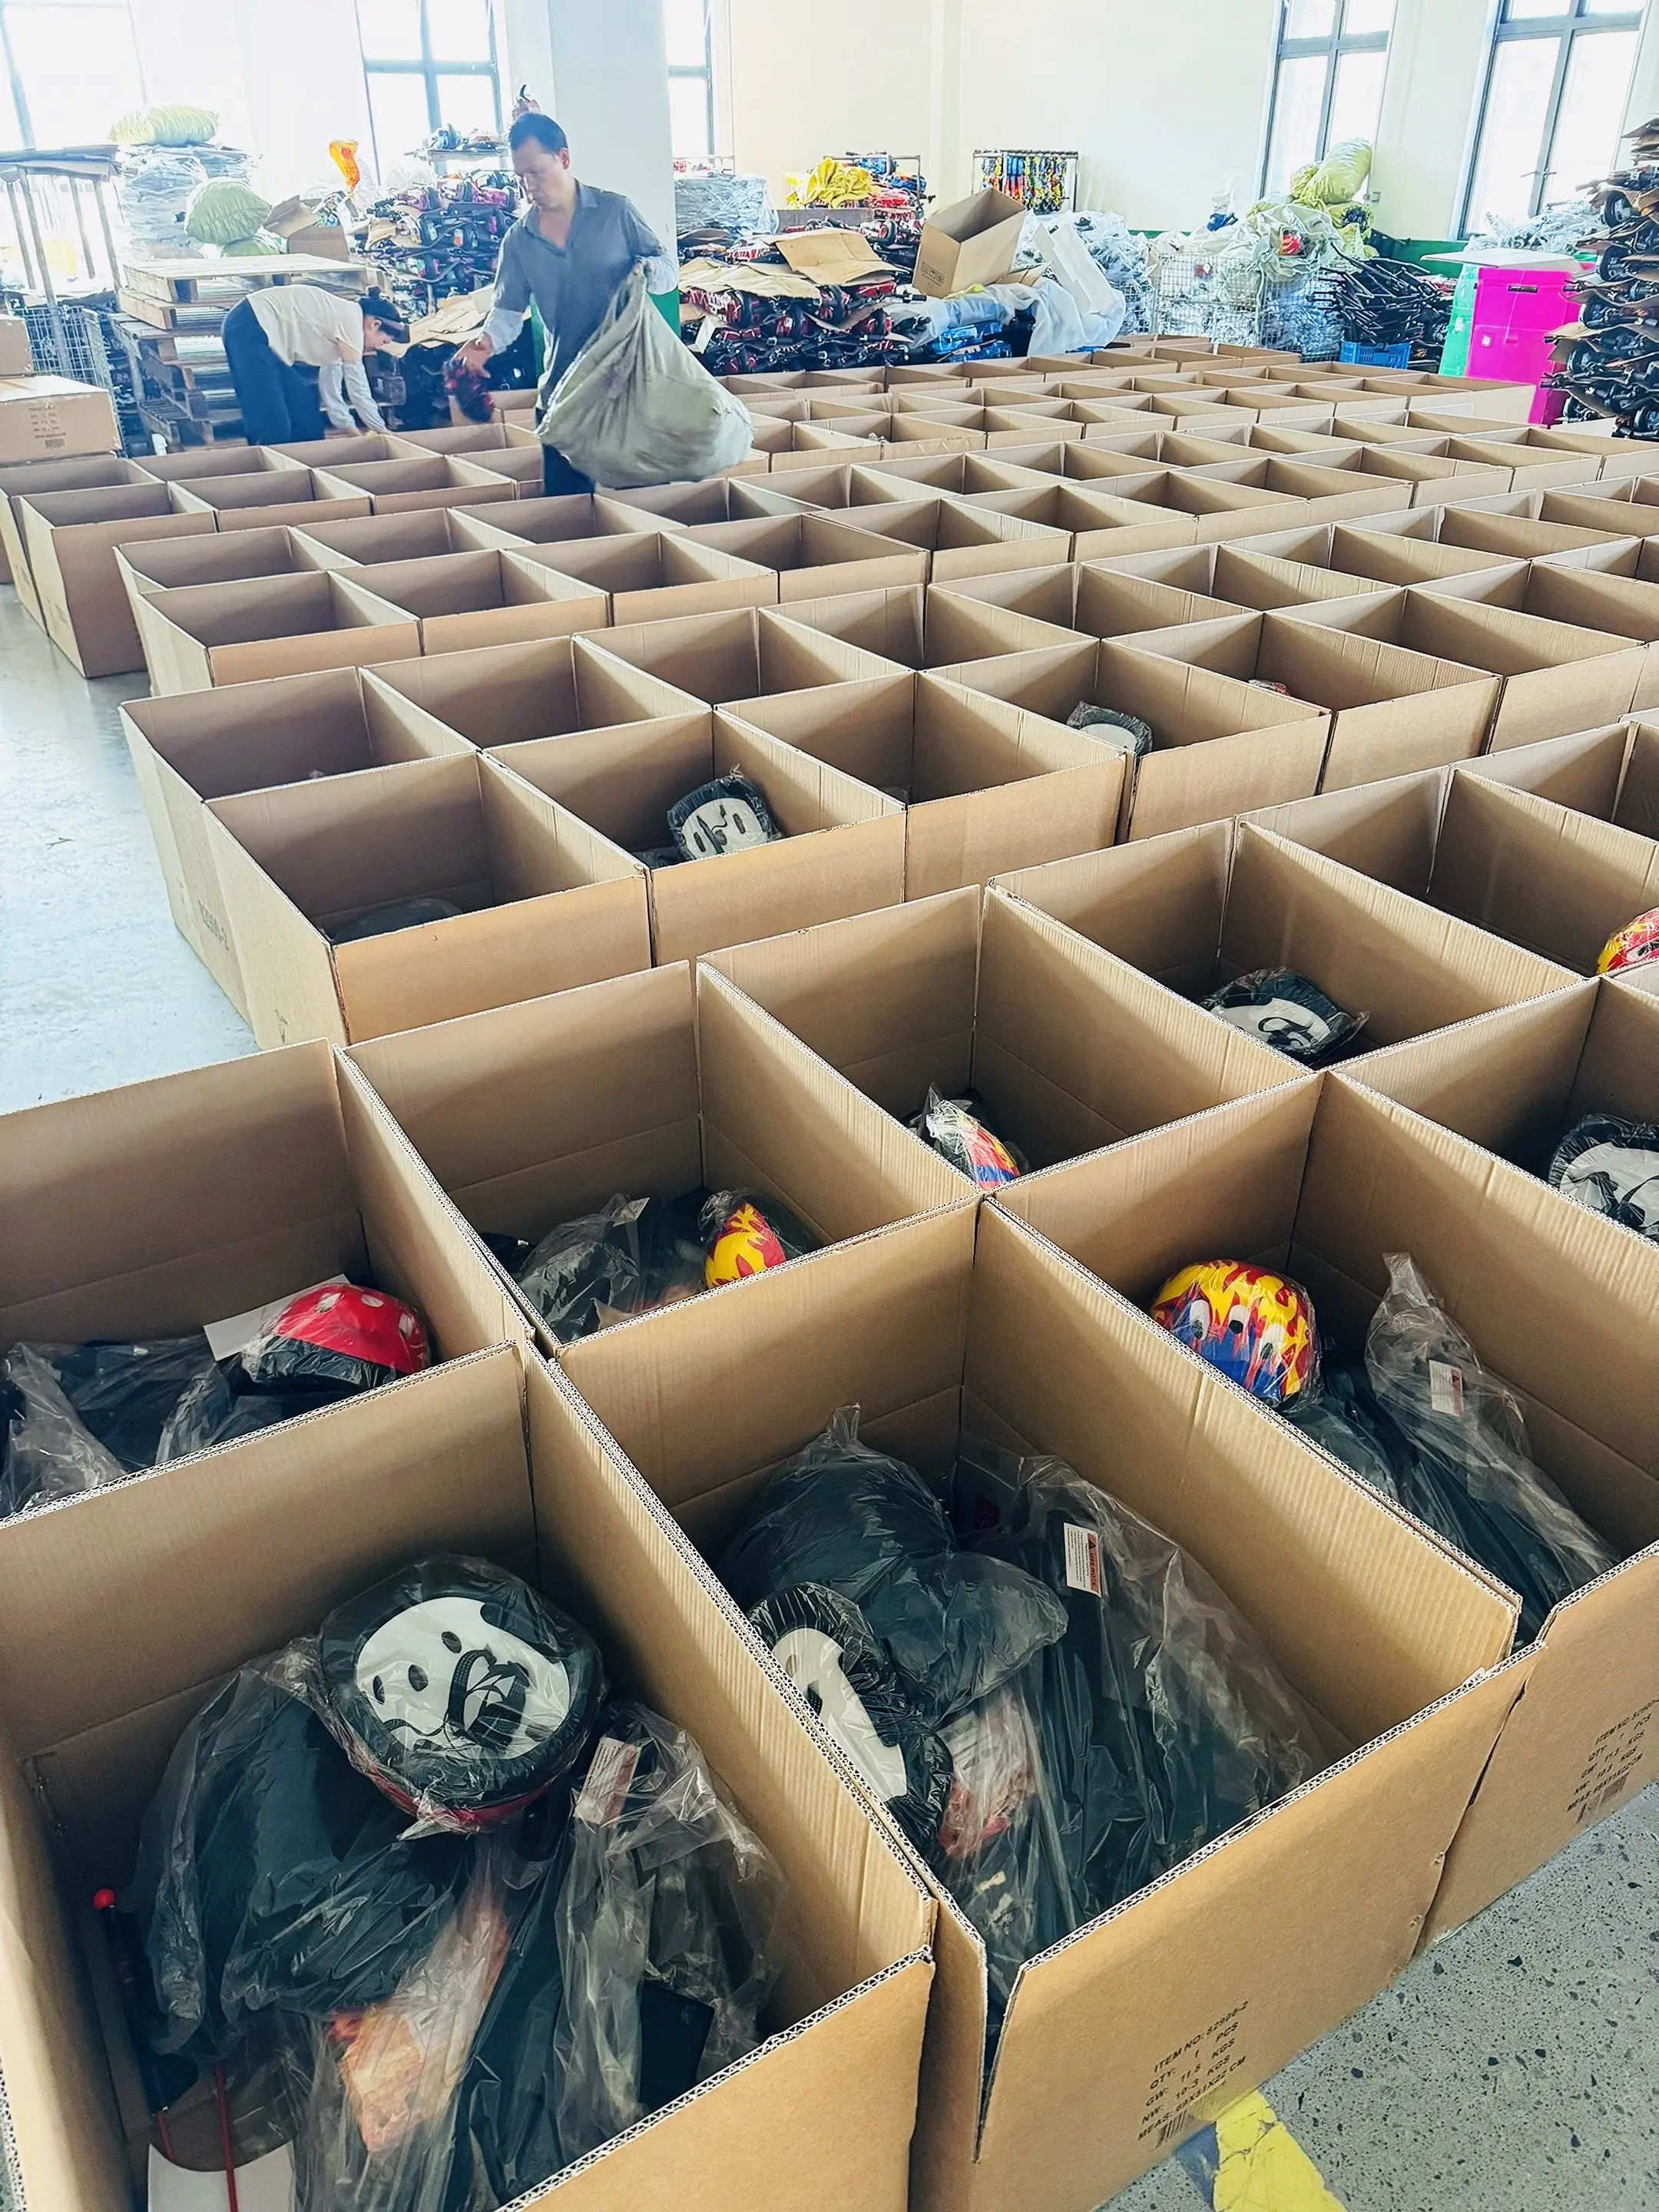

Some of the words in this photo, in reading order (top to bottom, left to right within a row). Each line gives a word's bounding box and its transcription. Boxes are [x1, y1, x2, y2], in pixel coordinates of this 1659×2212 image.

[1150, 2067, 1176, 2090] QTY:
[1215, 2021, 1239, 2043] PCS
[1154, 2047, 1183, 2073] ITEM
[1207, 2054, 1230, 2077] KGS
[1230, 2055, 1247, 2071] CM
[1146, 2087, 1169, 2107] GW:
[1211, 2037, 1236, 2059] KGS
